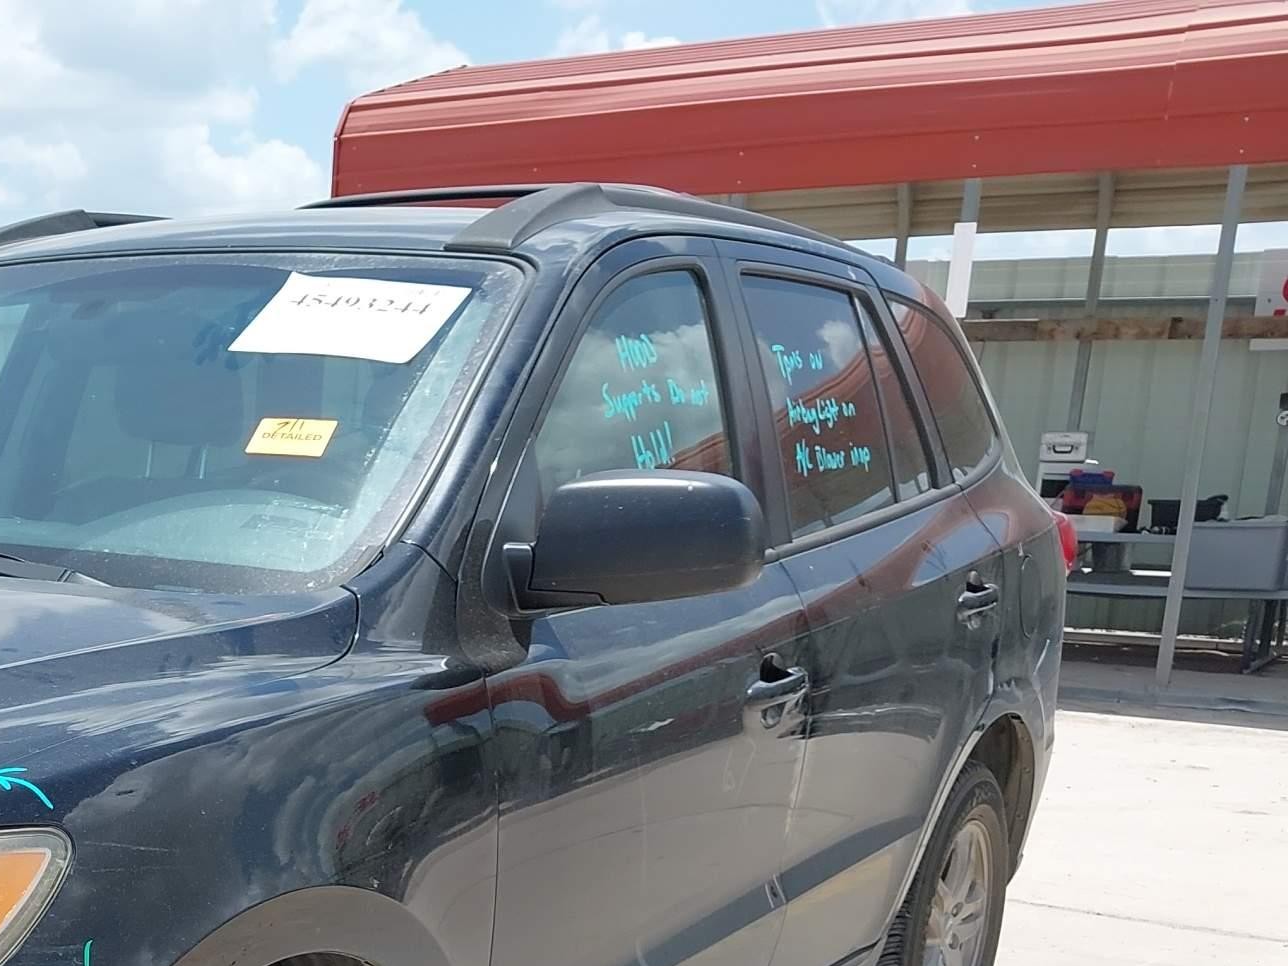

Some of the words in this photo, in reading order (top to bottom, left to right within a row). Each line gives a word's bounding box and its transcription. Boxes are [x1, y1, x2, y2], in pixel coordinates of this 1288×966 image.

[289, 293, 432, 315] 45493244
[601, 379, 661, 421] Supports
[841, 402, 856, 417] on
[261, 432, 323, 442] DETAILED
